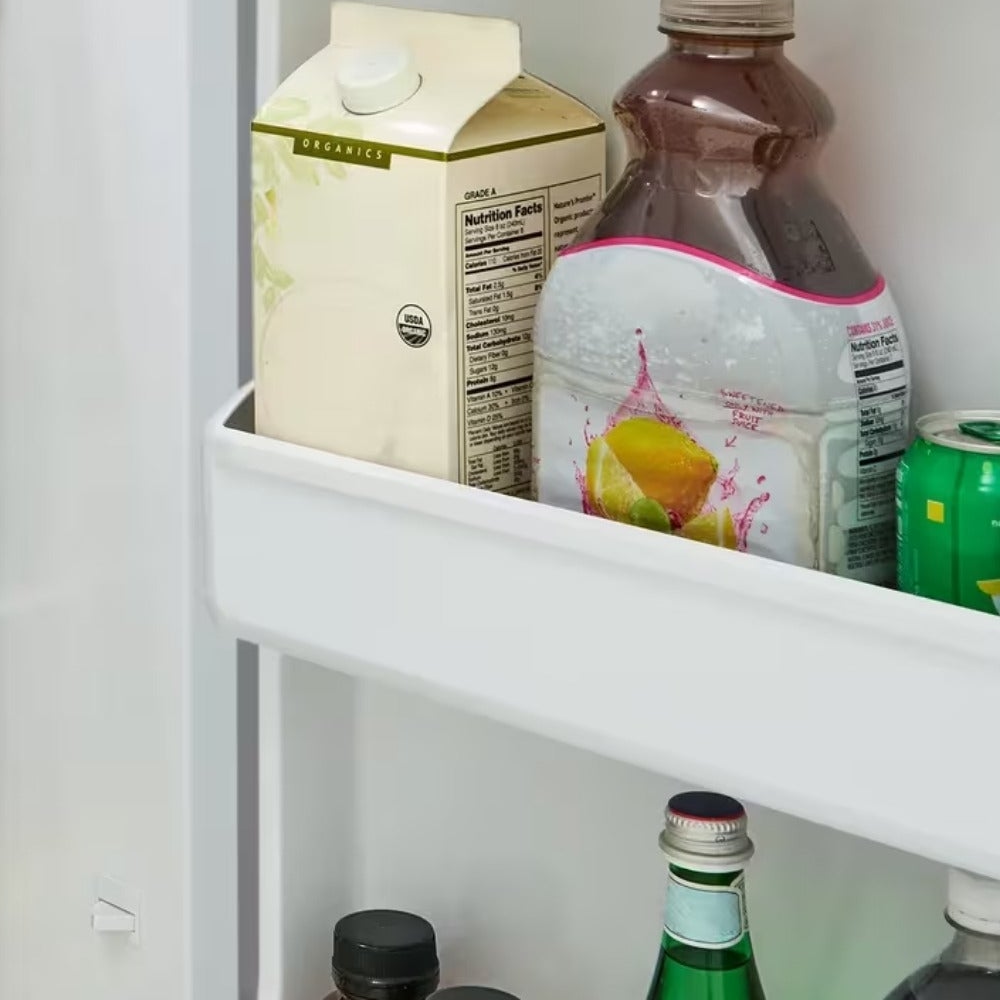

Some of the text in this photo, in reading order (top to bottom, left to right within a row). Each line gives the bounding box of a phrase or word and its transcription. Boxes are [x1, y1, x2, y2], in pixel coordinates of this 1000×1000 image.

[303, 138, 383, 160] ORGANICS
[464, 187, 497, 201] GRADE A
[465, 202, 543, 226] Nutrition Facts
[465, 227, 484, 236] Serving
[465, 229, 520, 245] Servings Per Container
[493, 246, 510, 254] Serving
[465, 260, 488, 270] Calories
[466, 283, 492, 294] Total Fat
[468, 295, 493, 305] Saturated
[493, 292, 501, 300] Fat
[403, 314, 424, 326] USDA
[466, 316, 501, 329] Cholesterol
[466, 331, 489, 341] Sodium
[466, 335, 521, 352] Total Carbohydrate
[851, 333, 899, 353] Nutrition Facts
[469, 351, 500, 364] Dietary Fiber
[469, 366, 488, 376] Sugars
[467, 377, 489, 387] Protein
[467, 394, 486, 403] Vitamin
[467, 405, 488, 416] Calcium
[467, 418, 486, 427] Vitamin
[732, 410, 763, 424] FRUIT
[731, 418, 759, 431] JUICE
